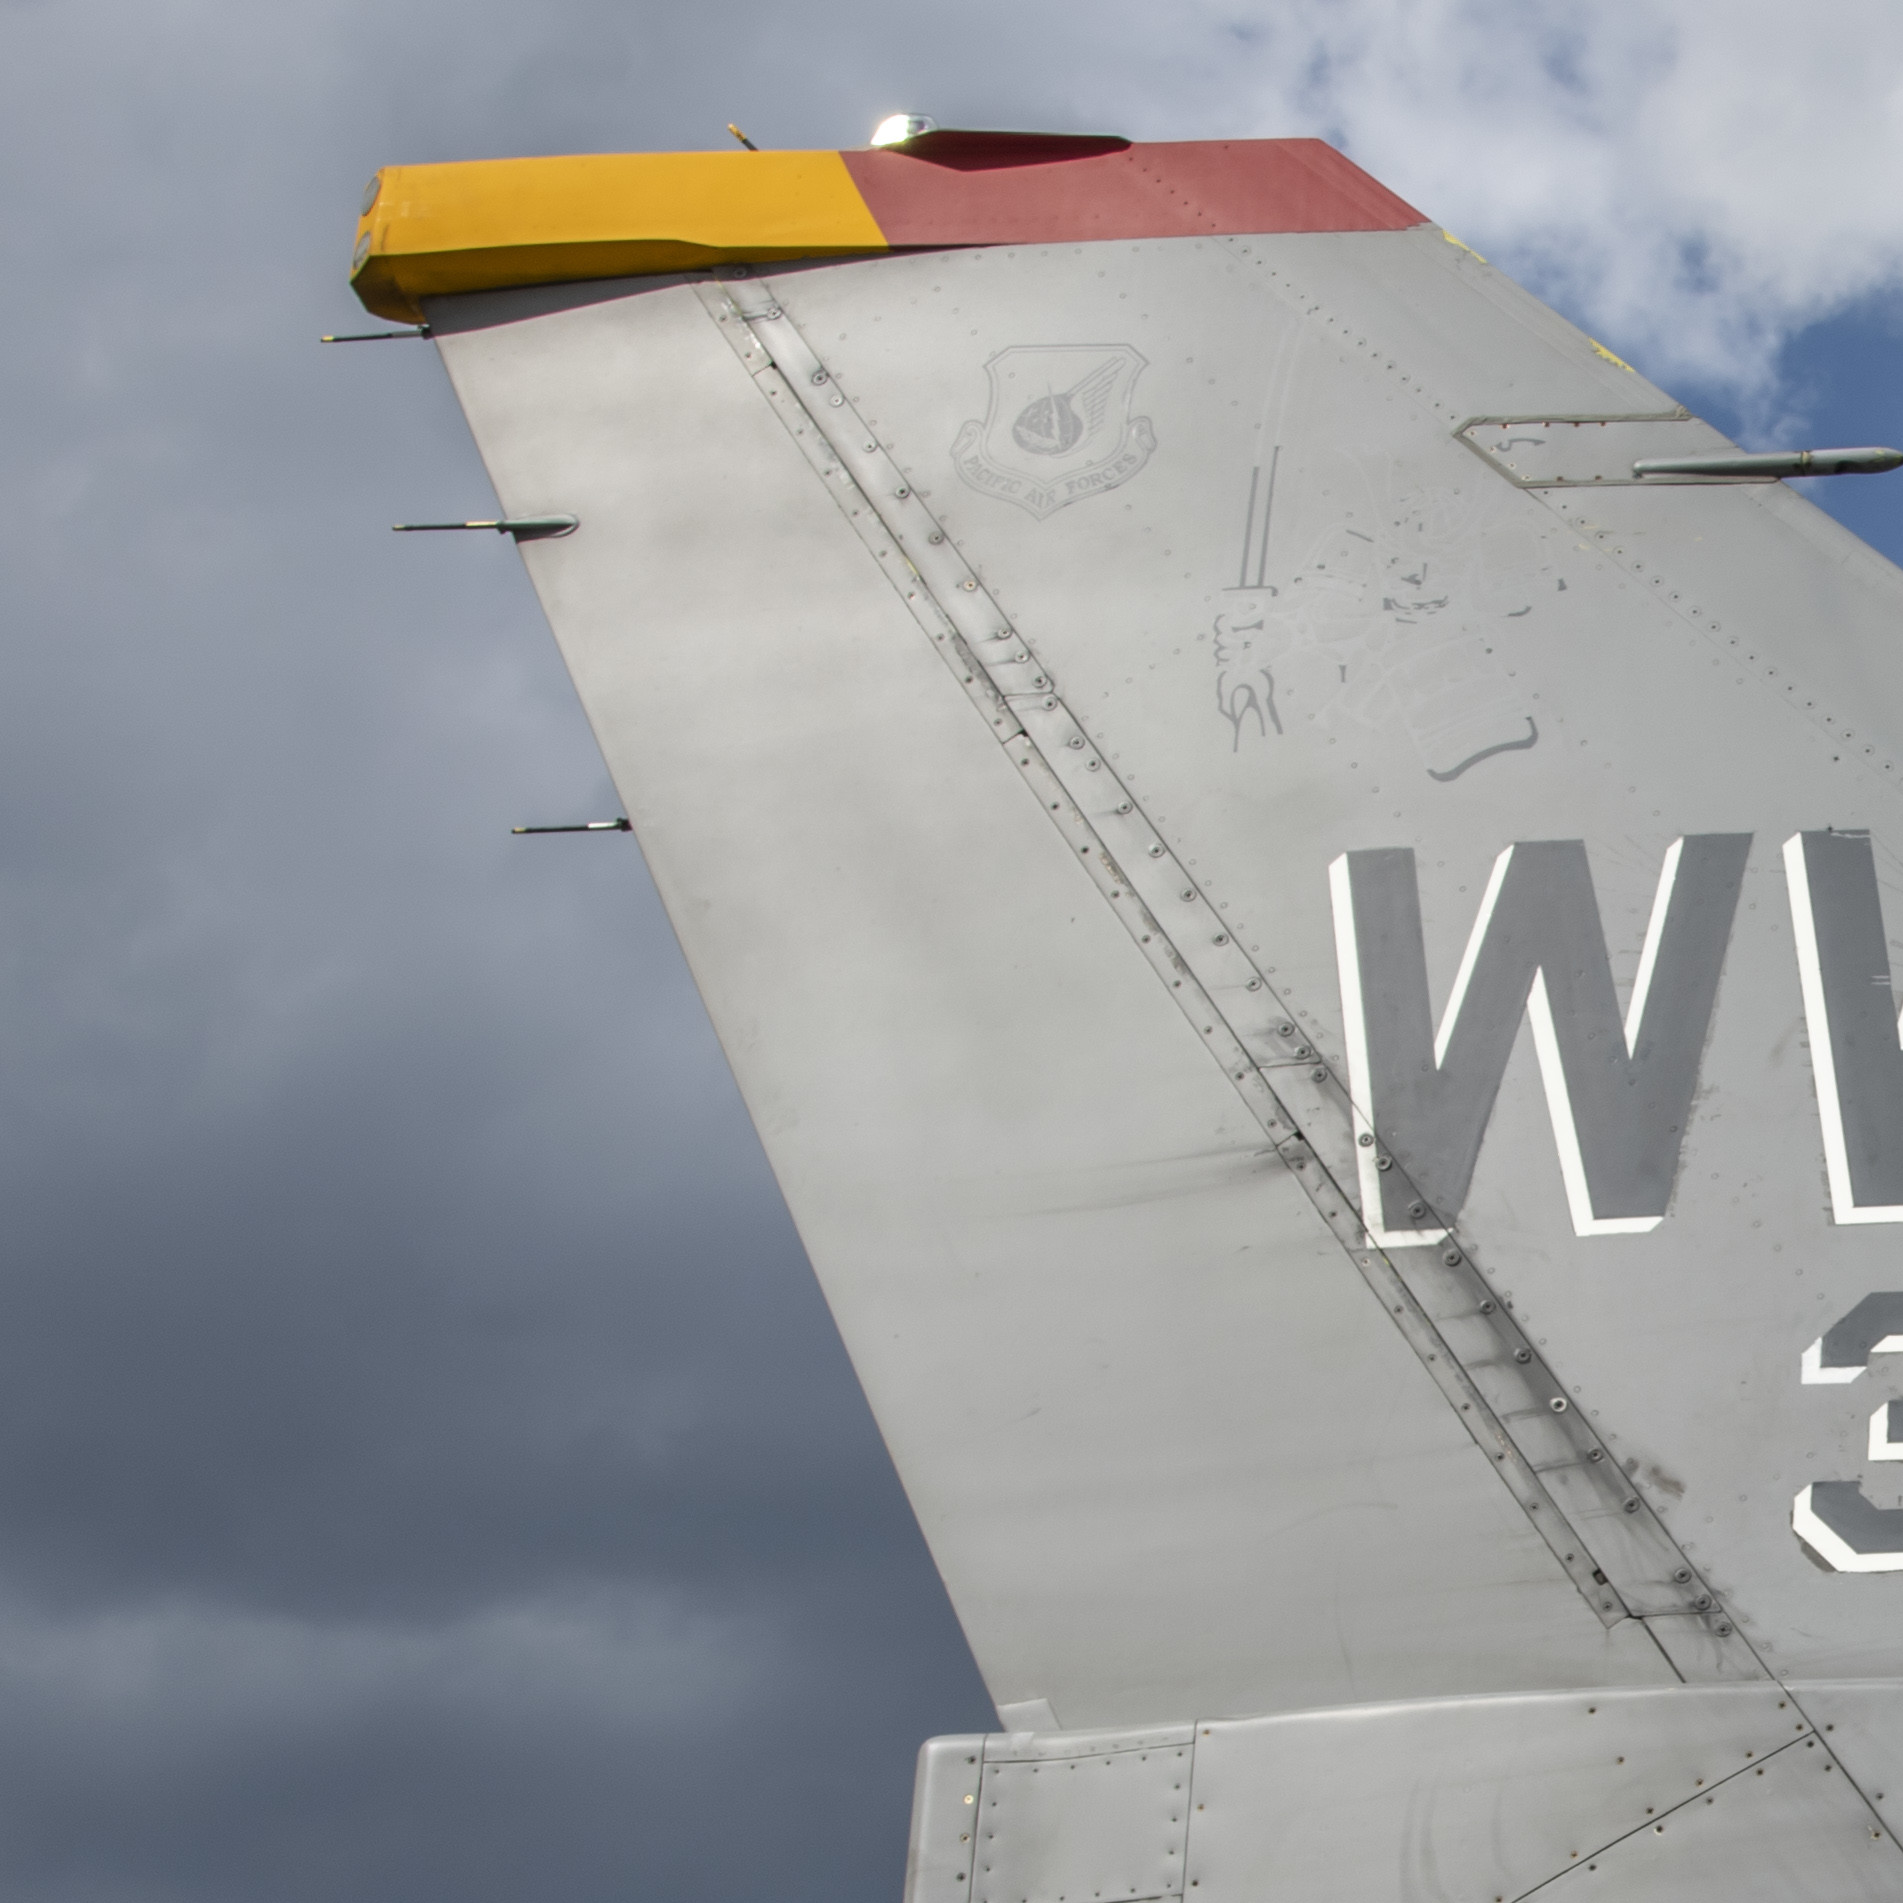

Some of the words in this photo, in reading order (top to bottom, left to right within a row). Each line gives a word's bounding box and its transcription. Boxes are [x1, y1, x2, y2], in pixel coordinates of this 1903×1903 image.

[963, 455, 1021, 493] PACIFIC
[1026, 488, 1056, 508] AIR
[1065, 452, 1137, 495] FORCES
